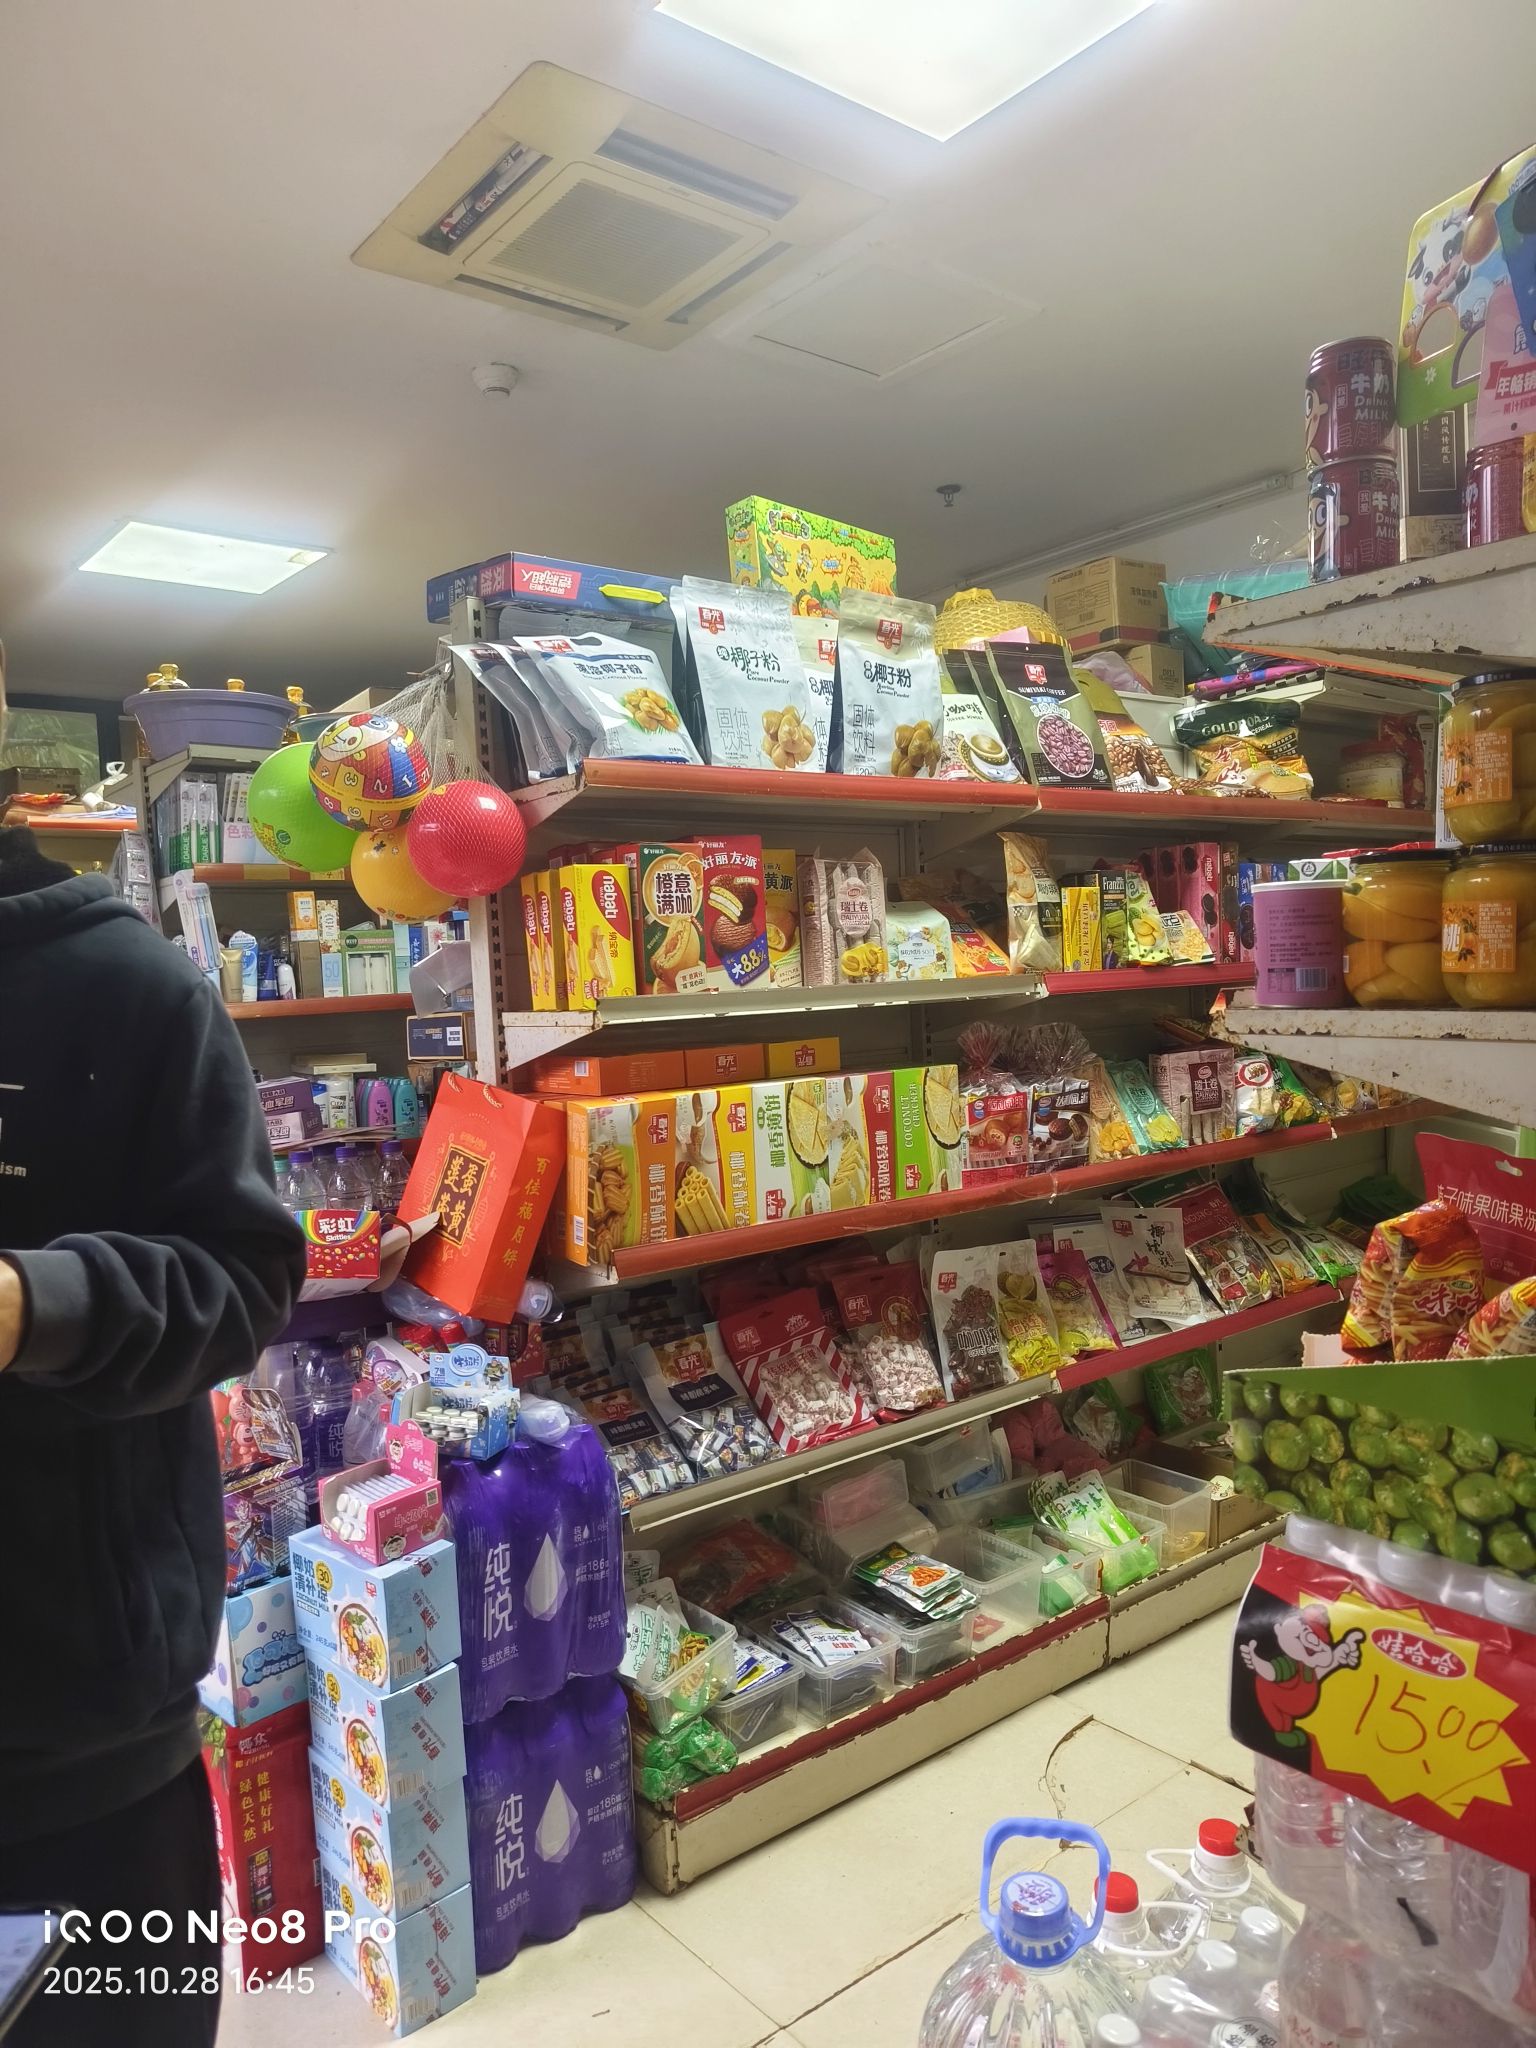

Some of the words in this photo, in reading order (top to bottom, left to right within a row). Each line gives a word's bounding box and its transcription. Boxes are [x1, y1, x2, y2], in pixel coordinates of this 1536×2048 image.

[1350, 372, 1390, 394] 牛奶
[1355, 409, 1389, 420] MILK
[701, 608, 723, 622] 春光
[882, 620, 902, 636] 春光
[655, 872, 692, 894] 橙意
[602, 875, 618, 920] nabati
[656, 895, 693, 916] 满咖
[840, 902, 869, 913] 瑞士卷
[526, 898, 536, 936] nabati
[541, 895, 549, 934] nabati
[563, 891, 575, 932] nabati
[739, 1105, 748, 1132] 春光
[911, 1083, 922, 1128] CRACKER
[657, 1116, 669, 1144] 春光
[765, 1094, 787, 1169] 椰香薄饼
[900, 1095, 914, 1149] COCONUT
[0, 1161, 27, 1177] ism
[318, 1217, 356, 1234] 彩虹
[325, 1233, 351, 1242] Skittles
[453, 1354, 482, 1368] 牛奶片
[441, 1397, 474, 1409] 牛奶片
[292, 1552, 315, 1580] 椰奶
[318, 1568, 330, 1583] 30
[484, 1542, 514, 1641] 纯悦
[481, 1644, 519, 1669] 包装饮用水
[239, 1778, 257, 1843] 绿色天然
[256, 1771, 275, 1834] 健康好礼
[495, 1792, 526, 1891] 纯悦
